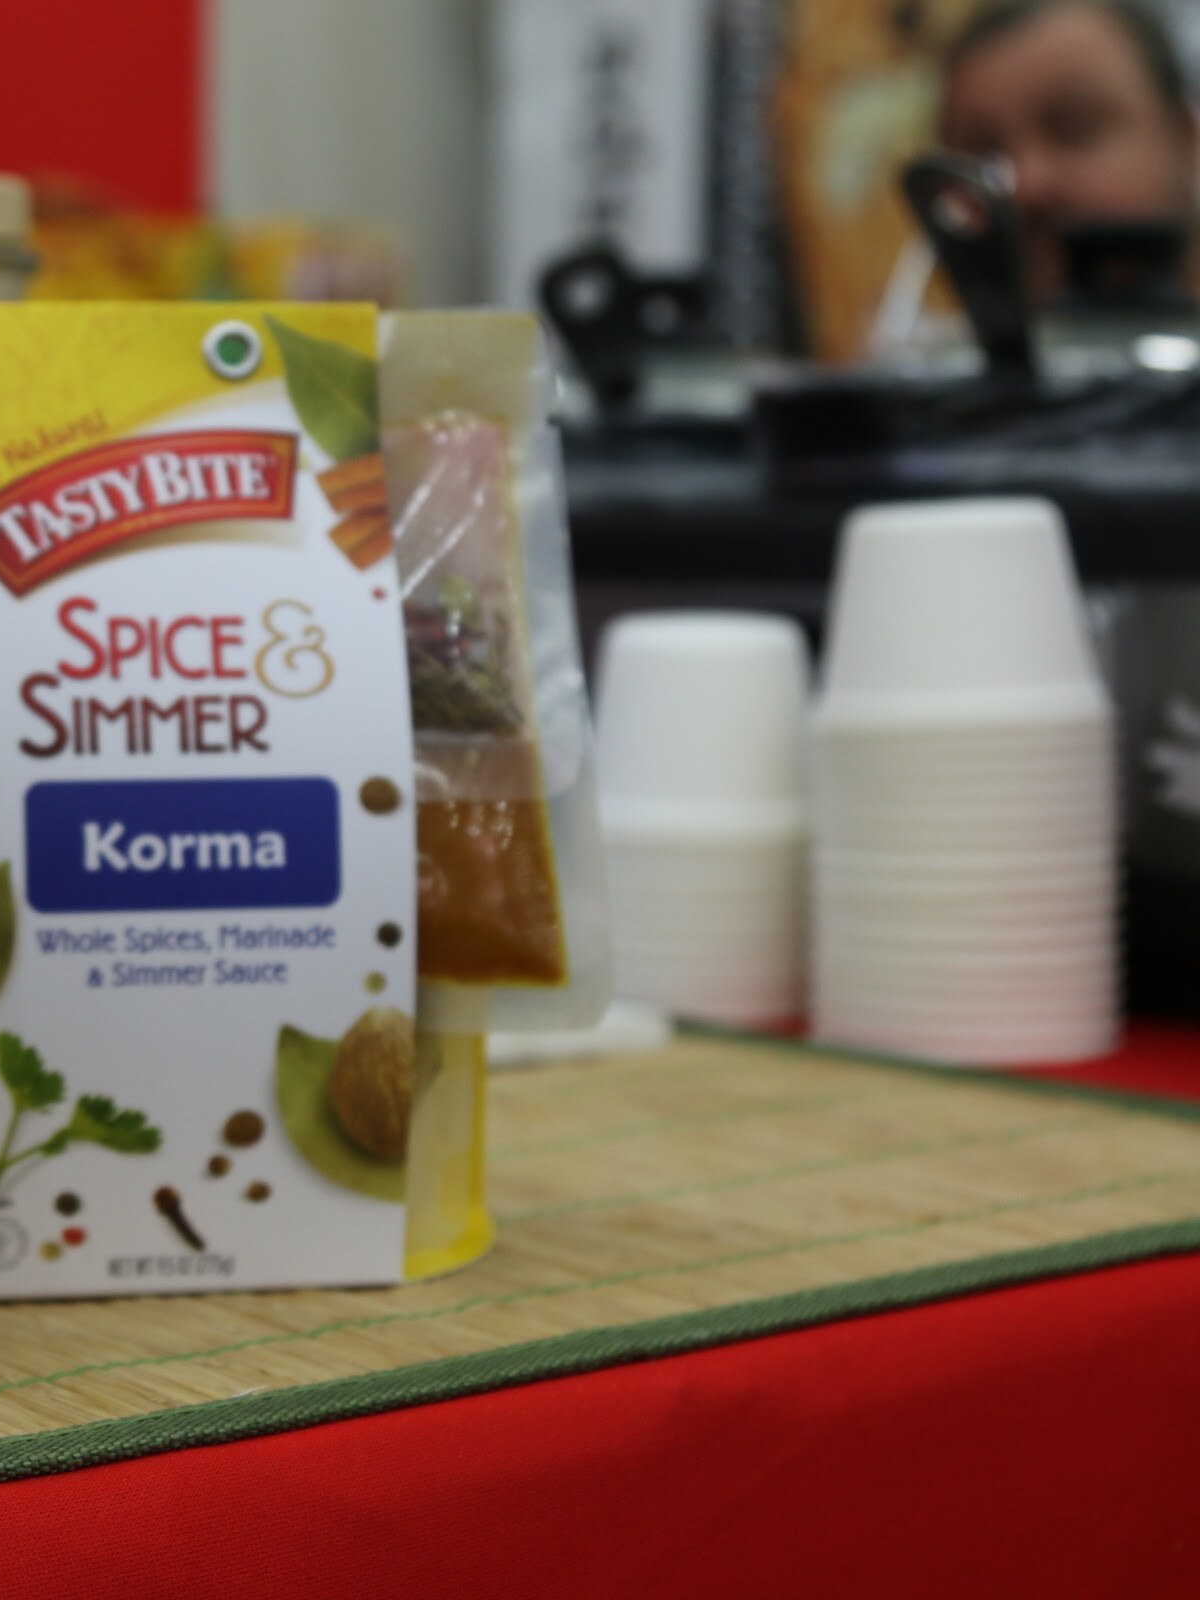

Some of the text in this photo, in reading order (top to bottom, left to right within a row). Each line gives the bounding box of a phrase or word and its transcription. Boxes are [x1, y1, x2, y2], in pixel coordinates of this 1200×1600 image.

[144, 450, 270, 504] BITE
[57, 597, 335, 699] SPICE &
[19, 672, 270, 759] SIMMER
[82, 821, 287, 872] Korma
[36, 927, 115, 954] Whole
[220, 923, 337, 950] Marinade
[113, 961, 206, 987] Simmer
[214, 960, 288, 984] Sauce
